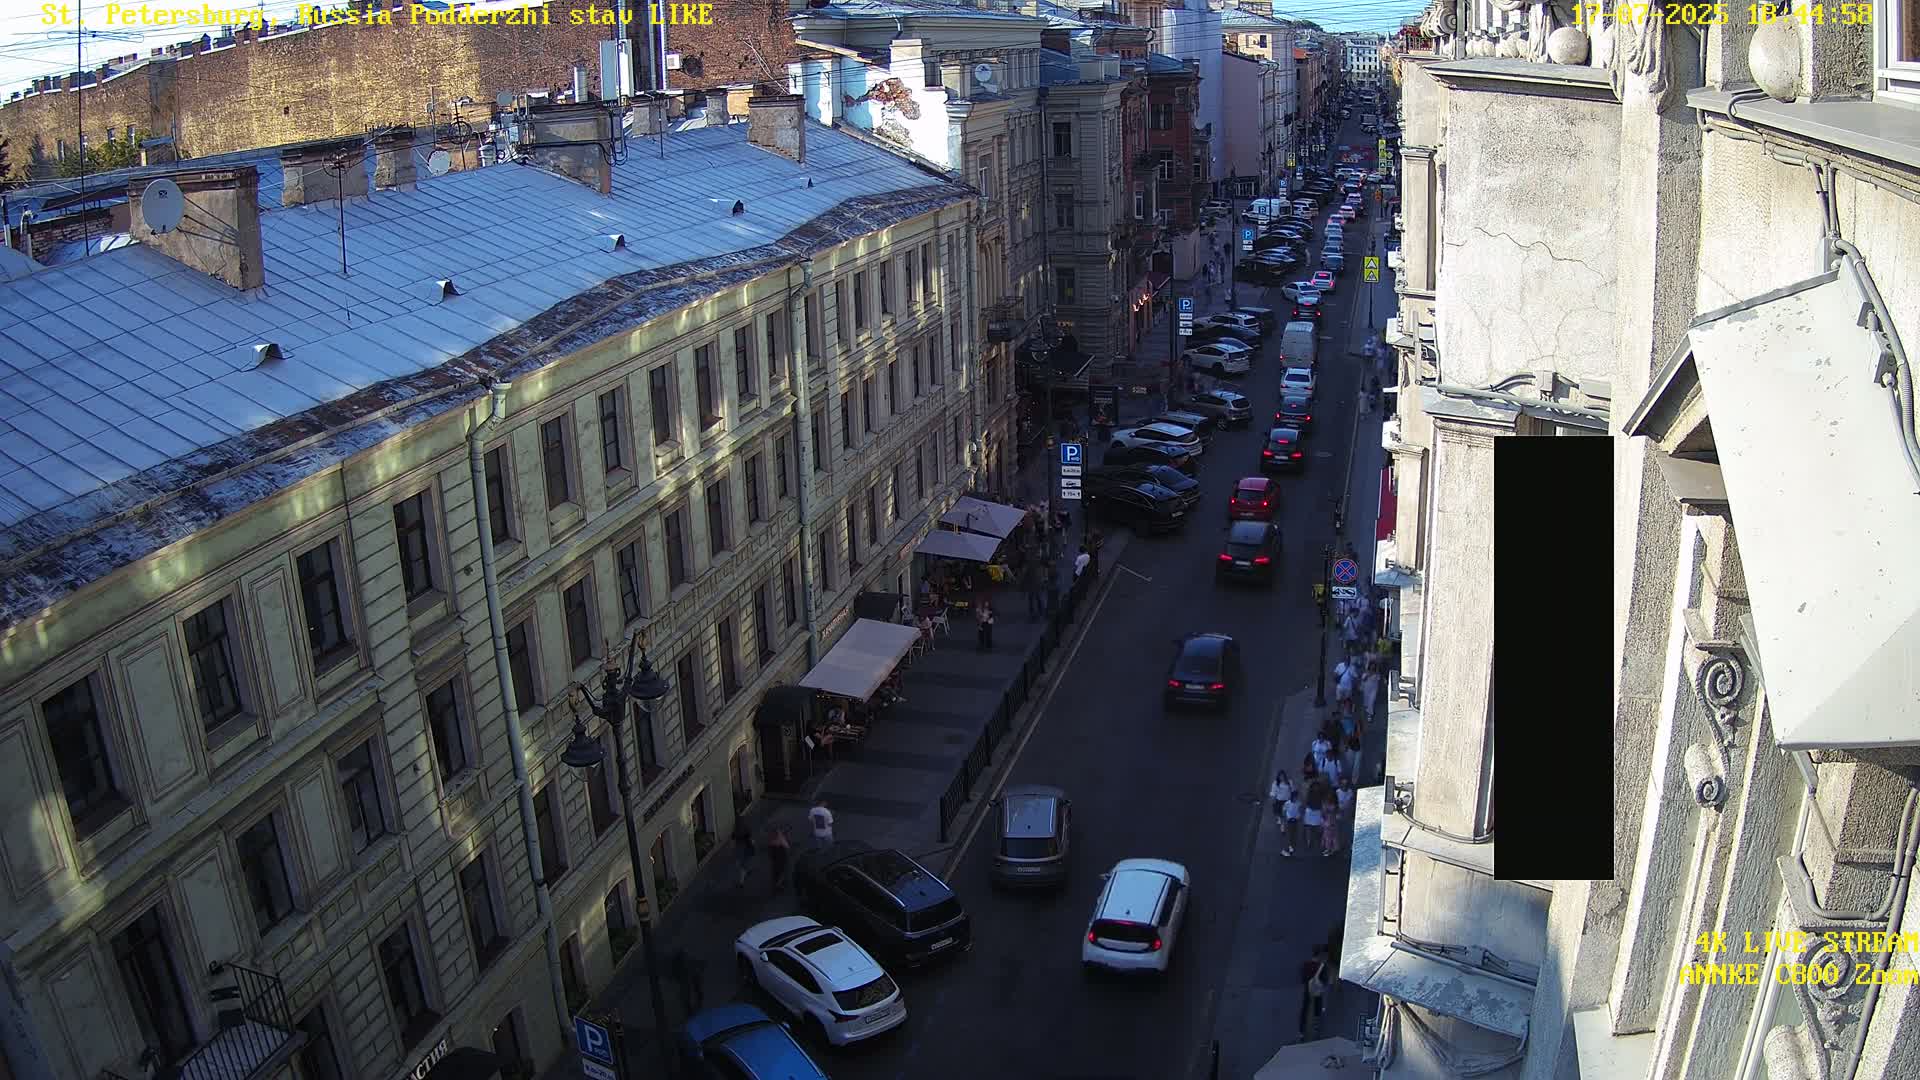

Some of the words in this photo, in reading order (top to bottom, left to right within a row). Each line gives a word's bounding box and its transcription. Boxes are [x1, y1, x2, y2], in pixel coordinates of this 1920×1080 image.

[1182, 299, 1191, 310] P
[1066, 445, 1078, 462] P
[583, 1023, 603, 1052] P
